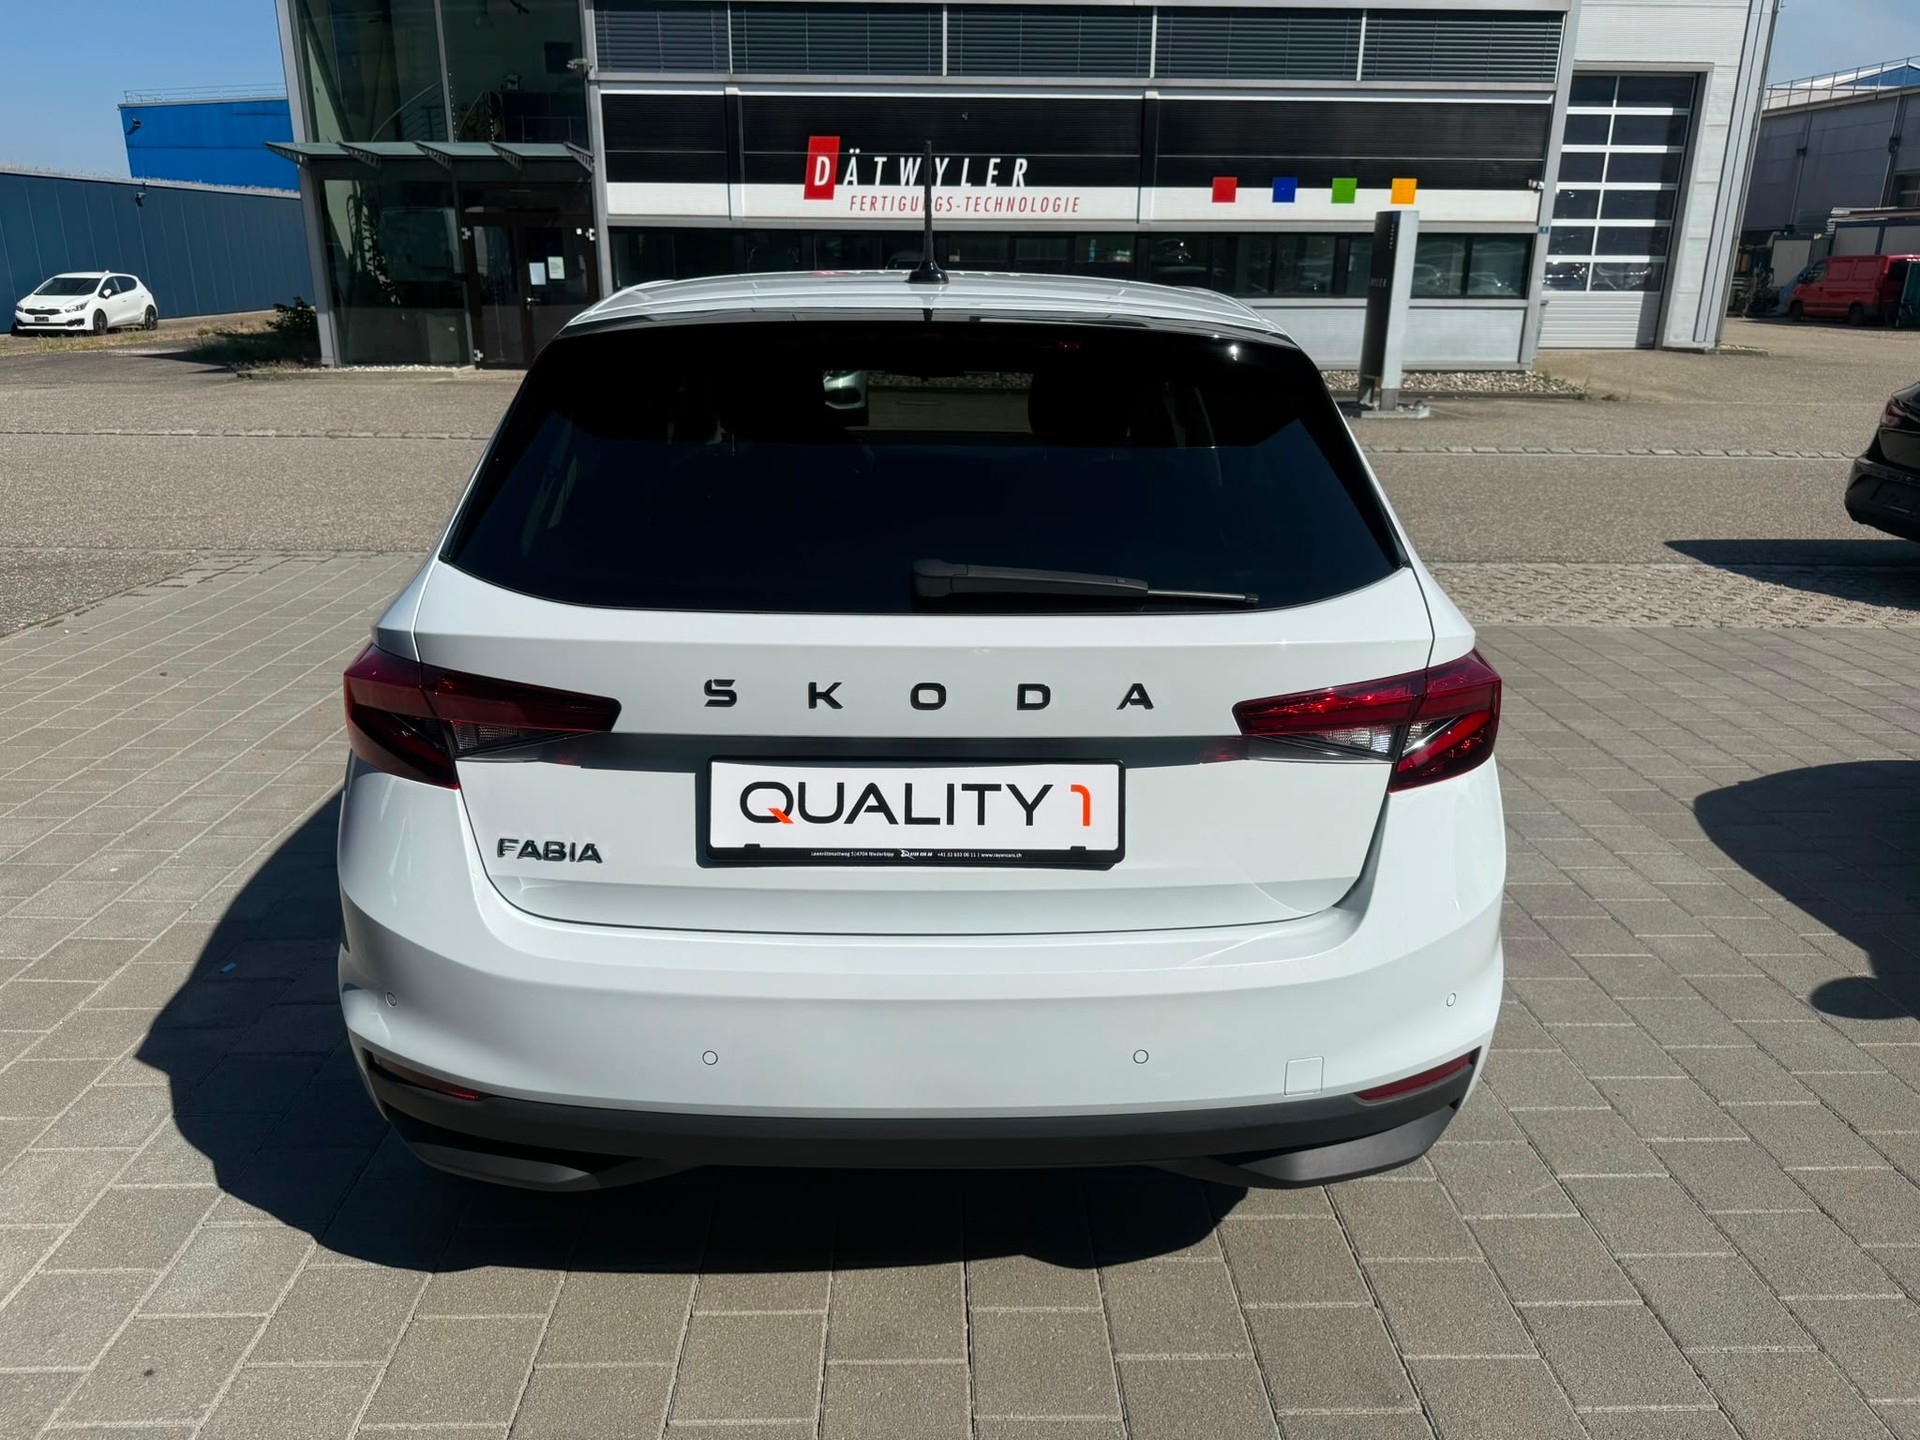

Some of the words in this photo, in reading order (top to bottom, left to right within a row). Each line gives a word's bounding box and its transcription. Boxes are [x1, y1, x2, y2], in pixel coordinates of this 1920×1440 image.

[813, 148, 1028, 187] DÄTWYLER
[849, 195, 1080, 213] FERTIGUGS-TECHNOLOGIE
[703, 678, 1155, 711] SKODA
[739, 781, 1054, 827] QUALITY
[1070, 784, 1091, 827] 1
[496, 837, 603, 864] FABIA
